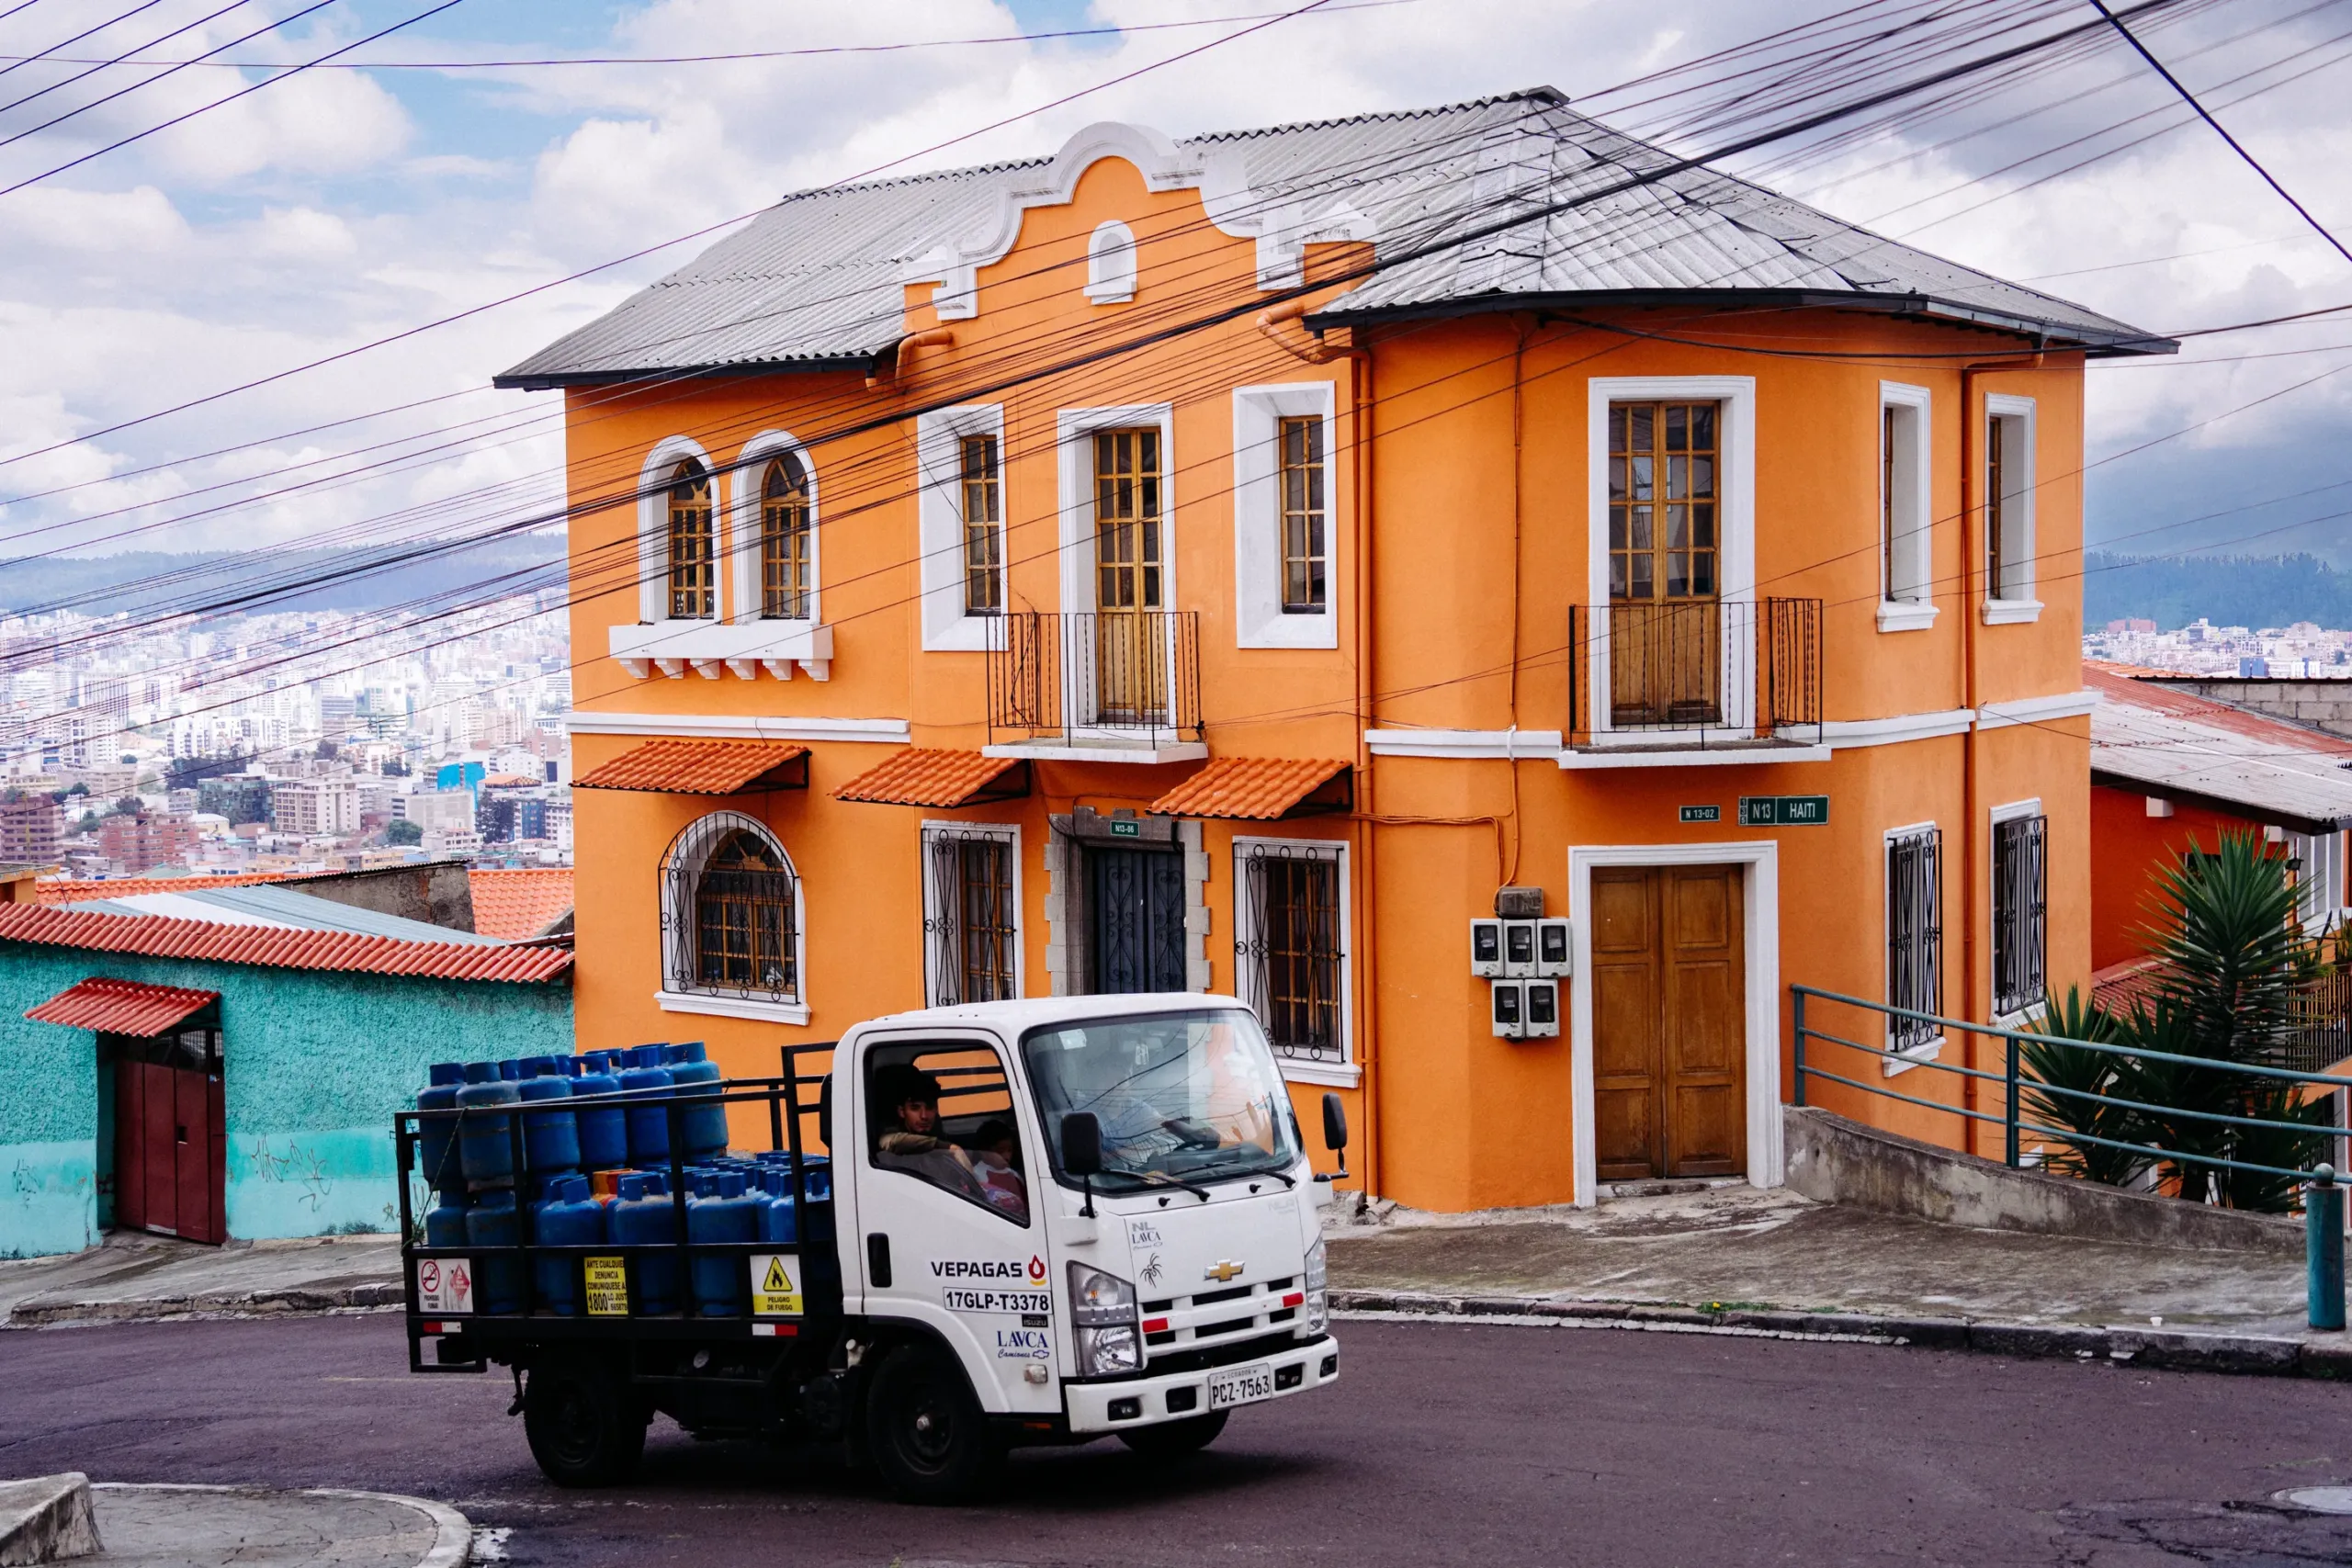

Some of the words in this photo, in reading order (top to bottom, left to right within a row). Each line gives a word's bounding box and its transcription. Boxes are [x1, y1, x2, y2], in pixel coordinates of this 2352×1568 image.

[1693, 808, 1715, 818] 13-02
[1789, 803, 1815, 818] HAITI
[586, 1259, 599, 1268] ANTE
[931, 1261, 1023, 1278] VEPAGAS
[594, 1270, 618, 1279] DENUNCIA
[588, 1292, 608, 1312] 1800
[946, 1292, 1049, 1312] 17GLP-T3378
[997, 1331, 1048, 1348] LAVCA
[998, 1348, 1030, 1359] Camiones
[1212, 1374, 1270, 1404] PCZ-7563
